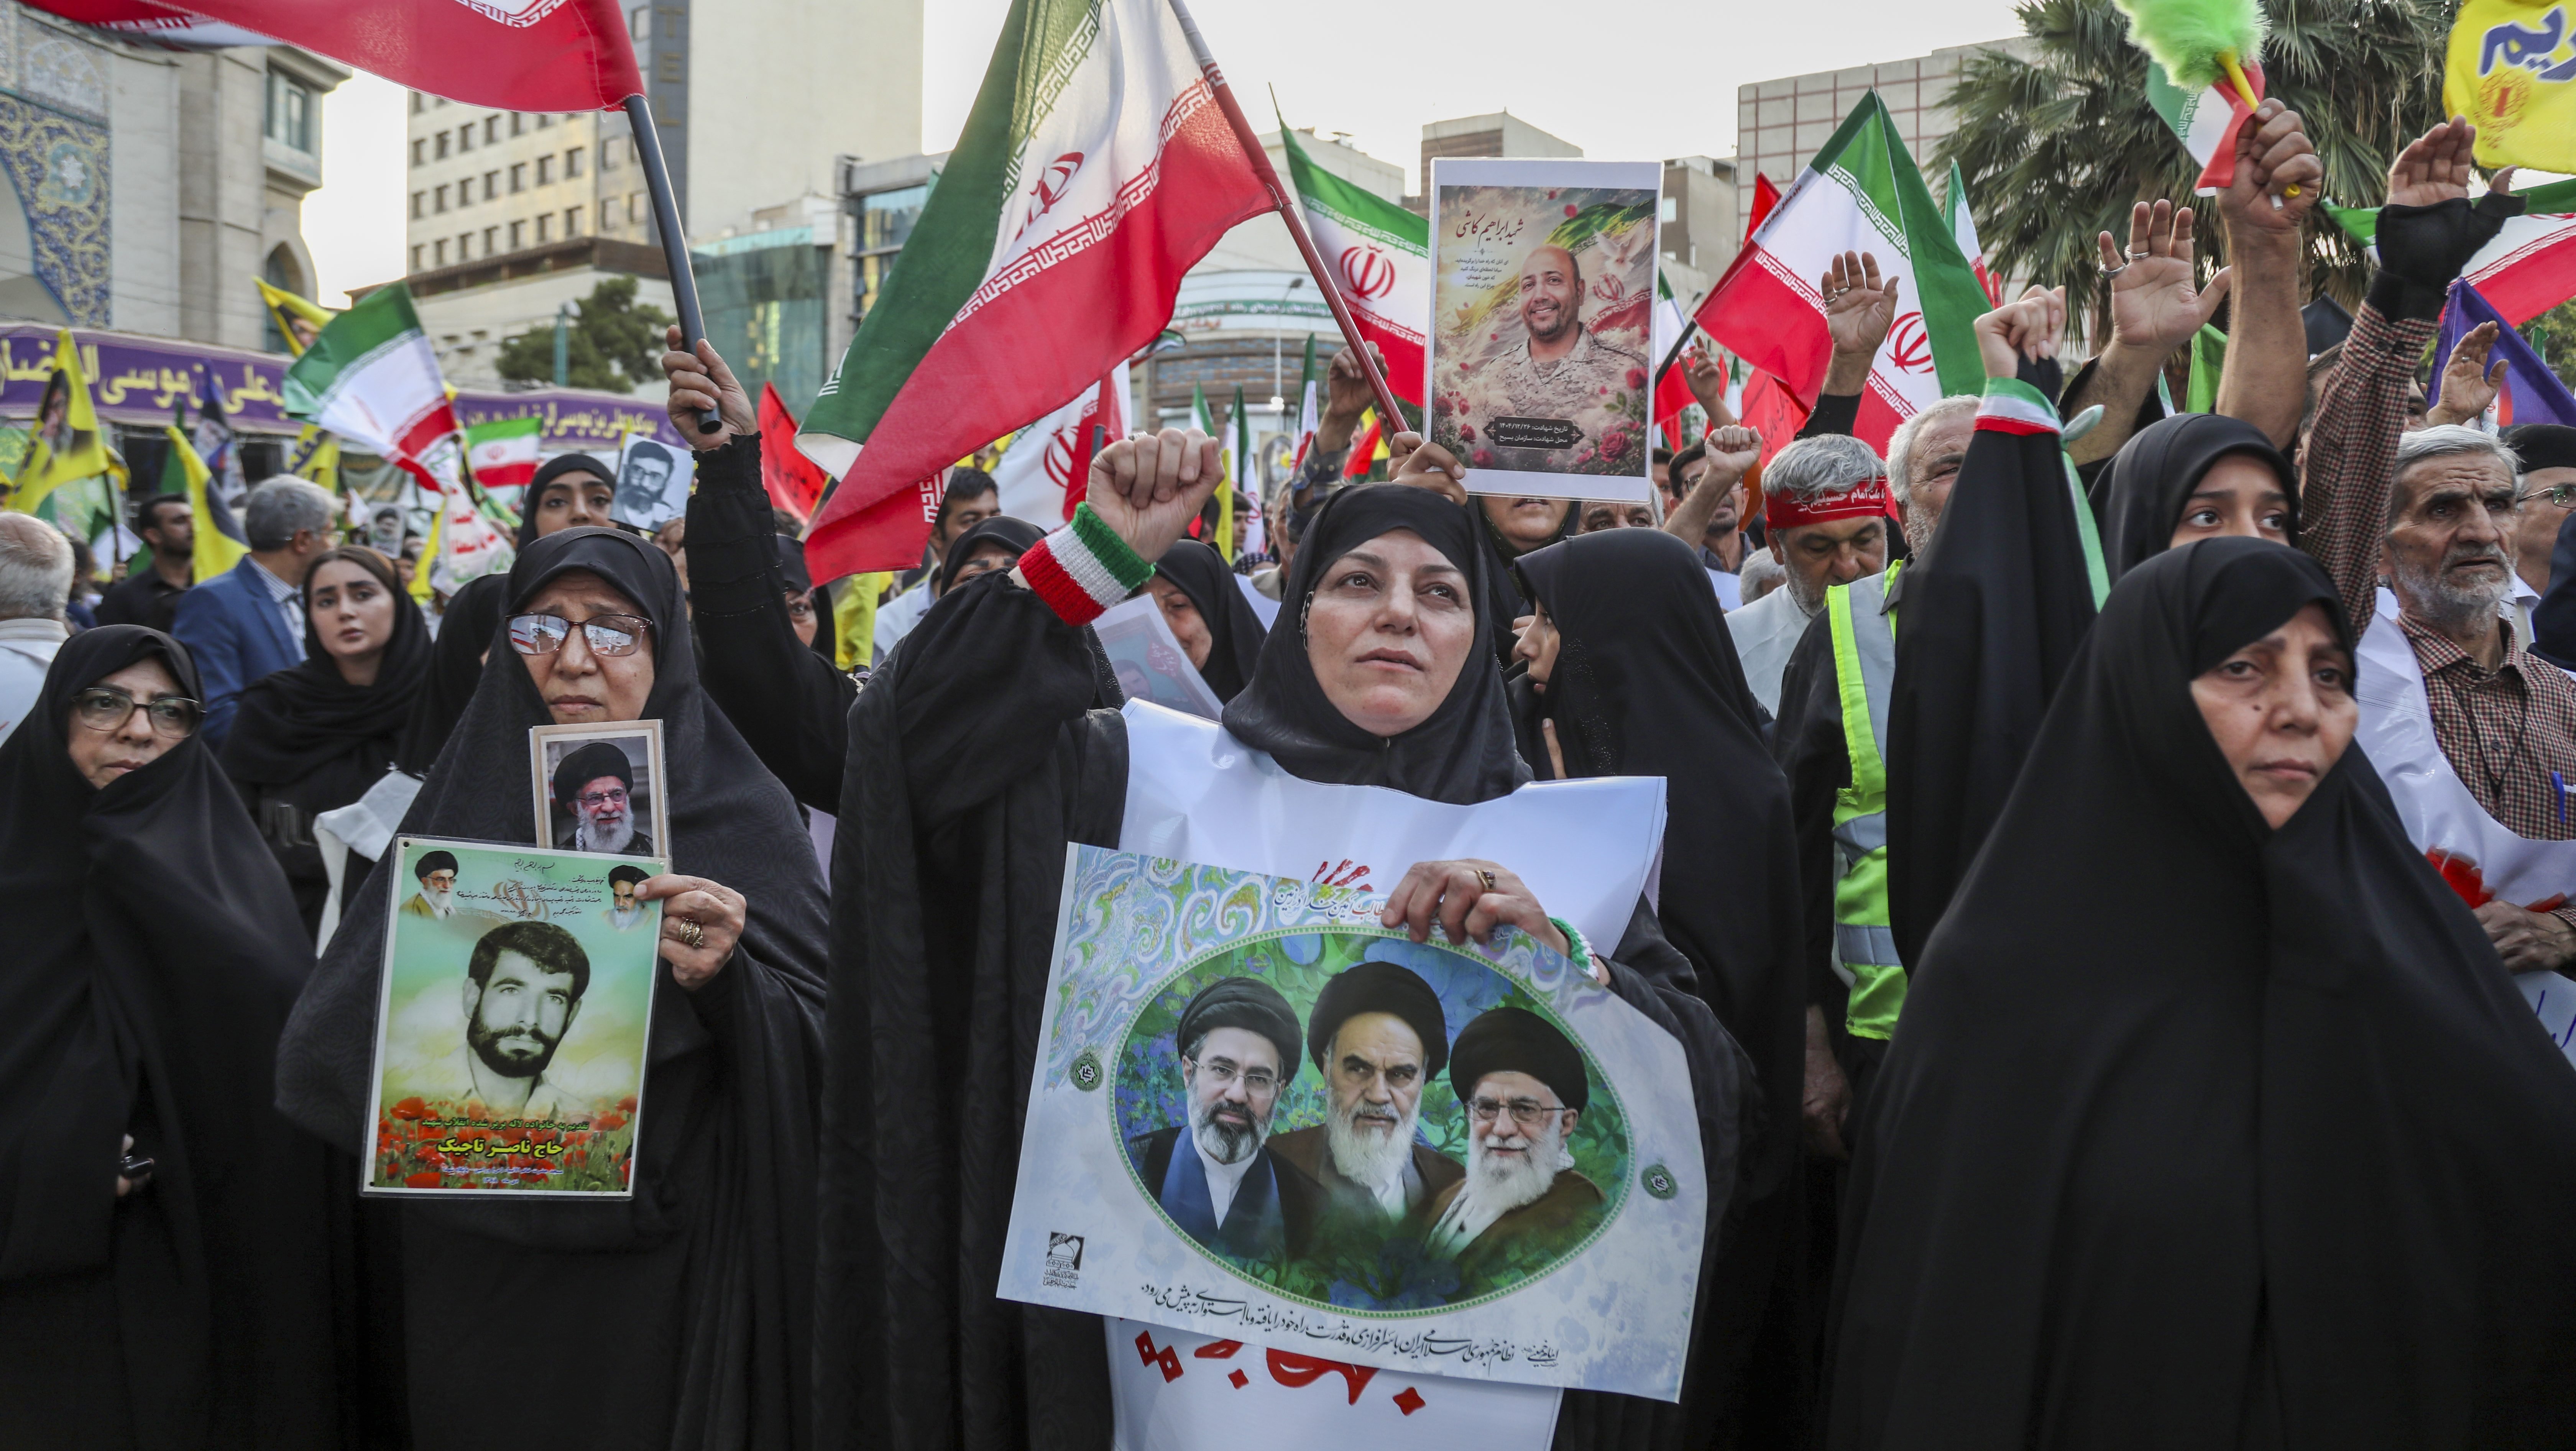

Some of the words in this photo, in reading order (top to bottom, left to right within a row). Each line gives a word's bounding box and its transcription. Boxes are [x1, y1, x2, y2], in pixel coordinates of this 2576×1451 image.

[1456, 210, 1487, 238] کاشی
[1478, 218, 1509, 249] ابراهیم
[1505, 218, 1524, 245] شهید
[99, 367, 191, 409] موسی
[1553, 425, 1568, 433] تاریخ
[422, 1118, 442, 1128] شهید
[444, 1117, 470, 1128] انقلاب
[471, 1118, 489, 1128] شده
[509, 1119, 524, 1128] لاله
[525, 1120, 556, 1131] خانواده
[557, 1122, 566, 1131] به
[567, 1121, 590, 1131] تقدیم
[437, 1138, 485, 1156] تاجیک
[486, 1139, 531, 1157] ناصر
[533, 1140, 564, 1158] حاج
[1488, 1340, 1515, 1377] نظام
